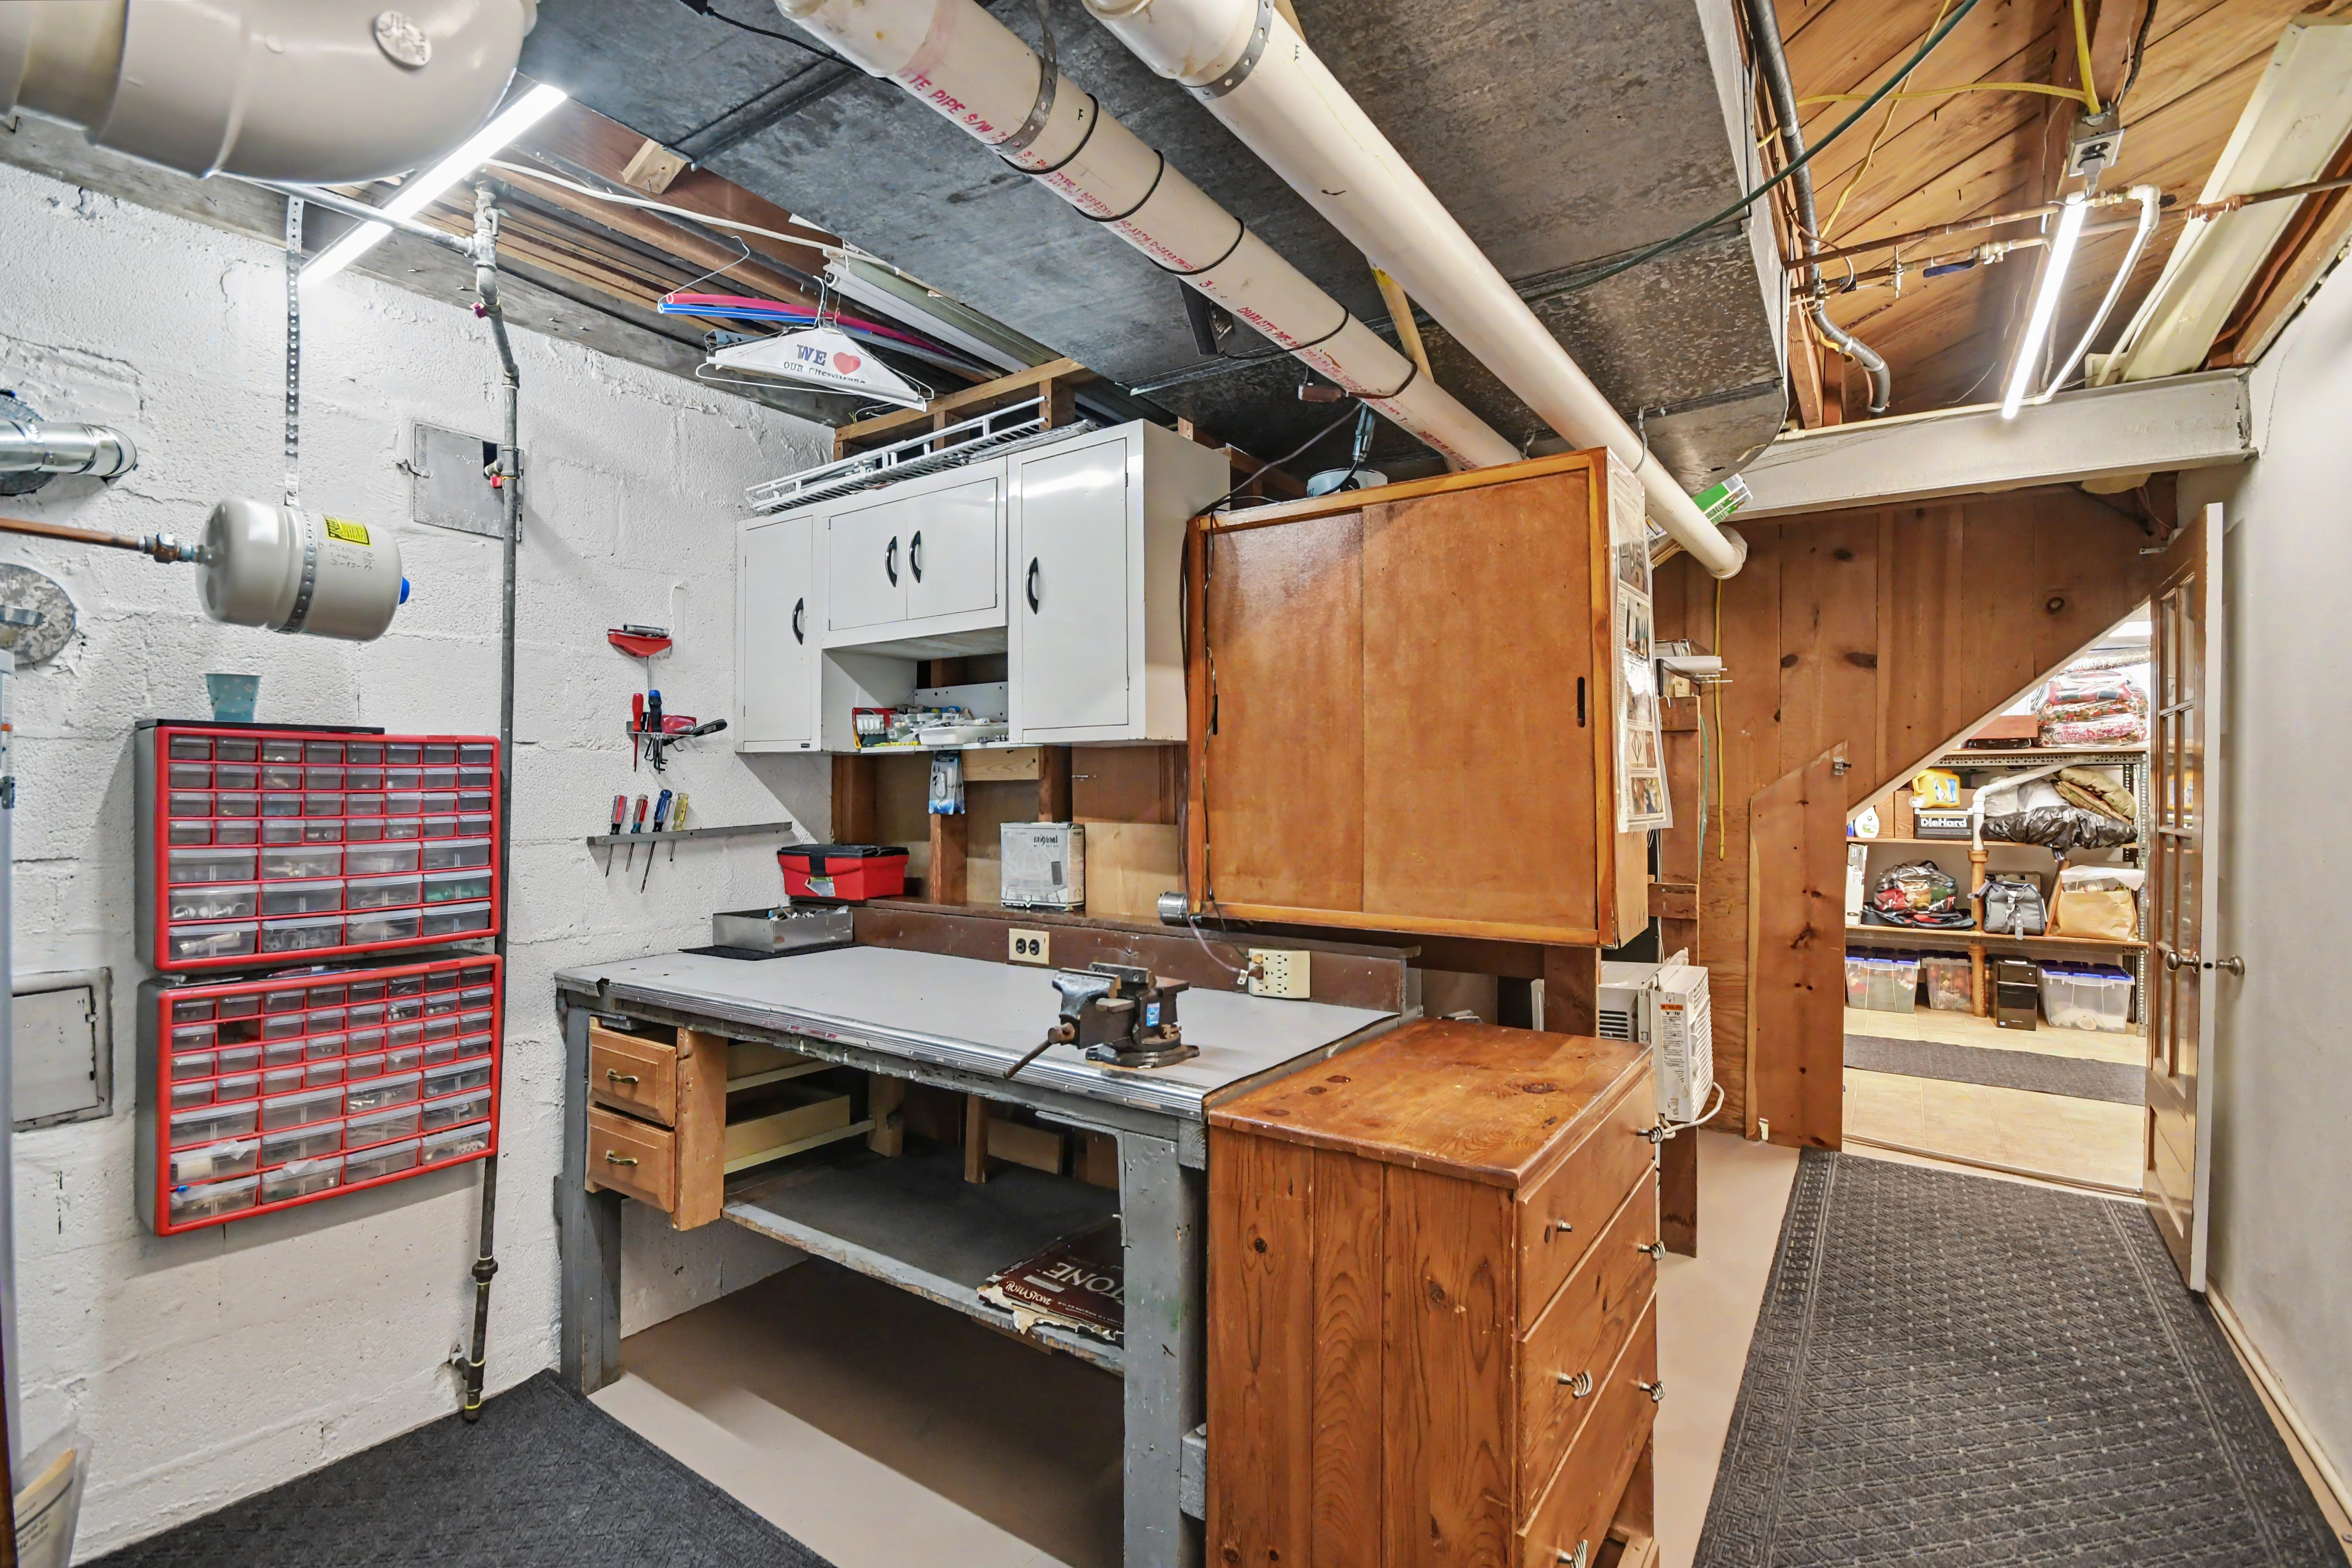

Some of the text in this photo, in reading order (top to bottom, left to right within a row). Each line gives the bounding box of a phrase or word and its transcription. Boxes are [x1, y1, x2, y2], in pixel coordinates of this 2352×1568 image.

[928, 90, 966, 114] PIPE
[797, 344, 827, 366] WE
[784, 361, 803, 372] OUR
